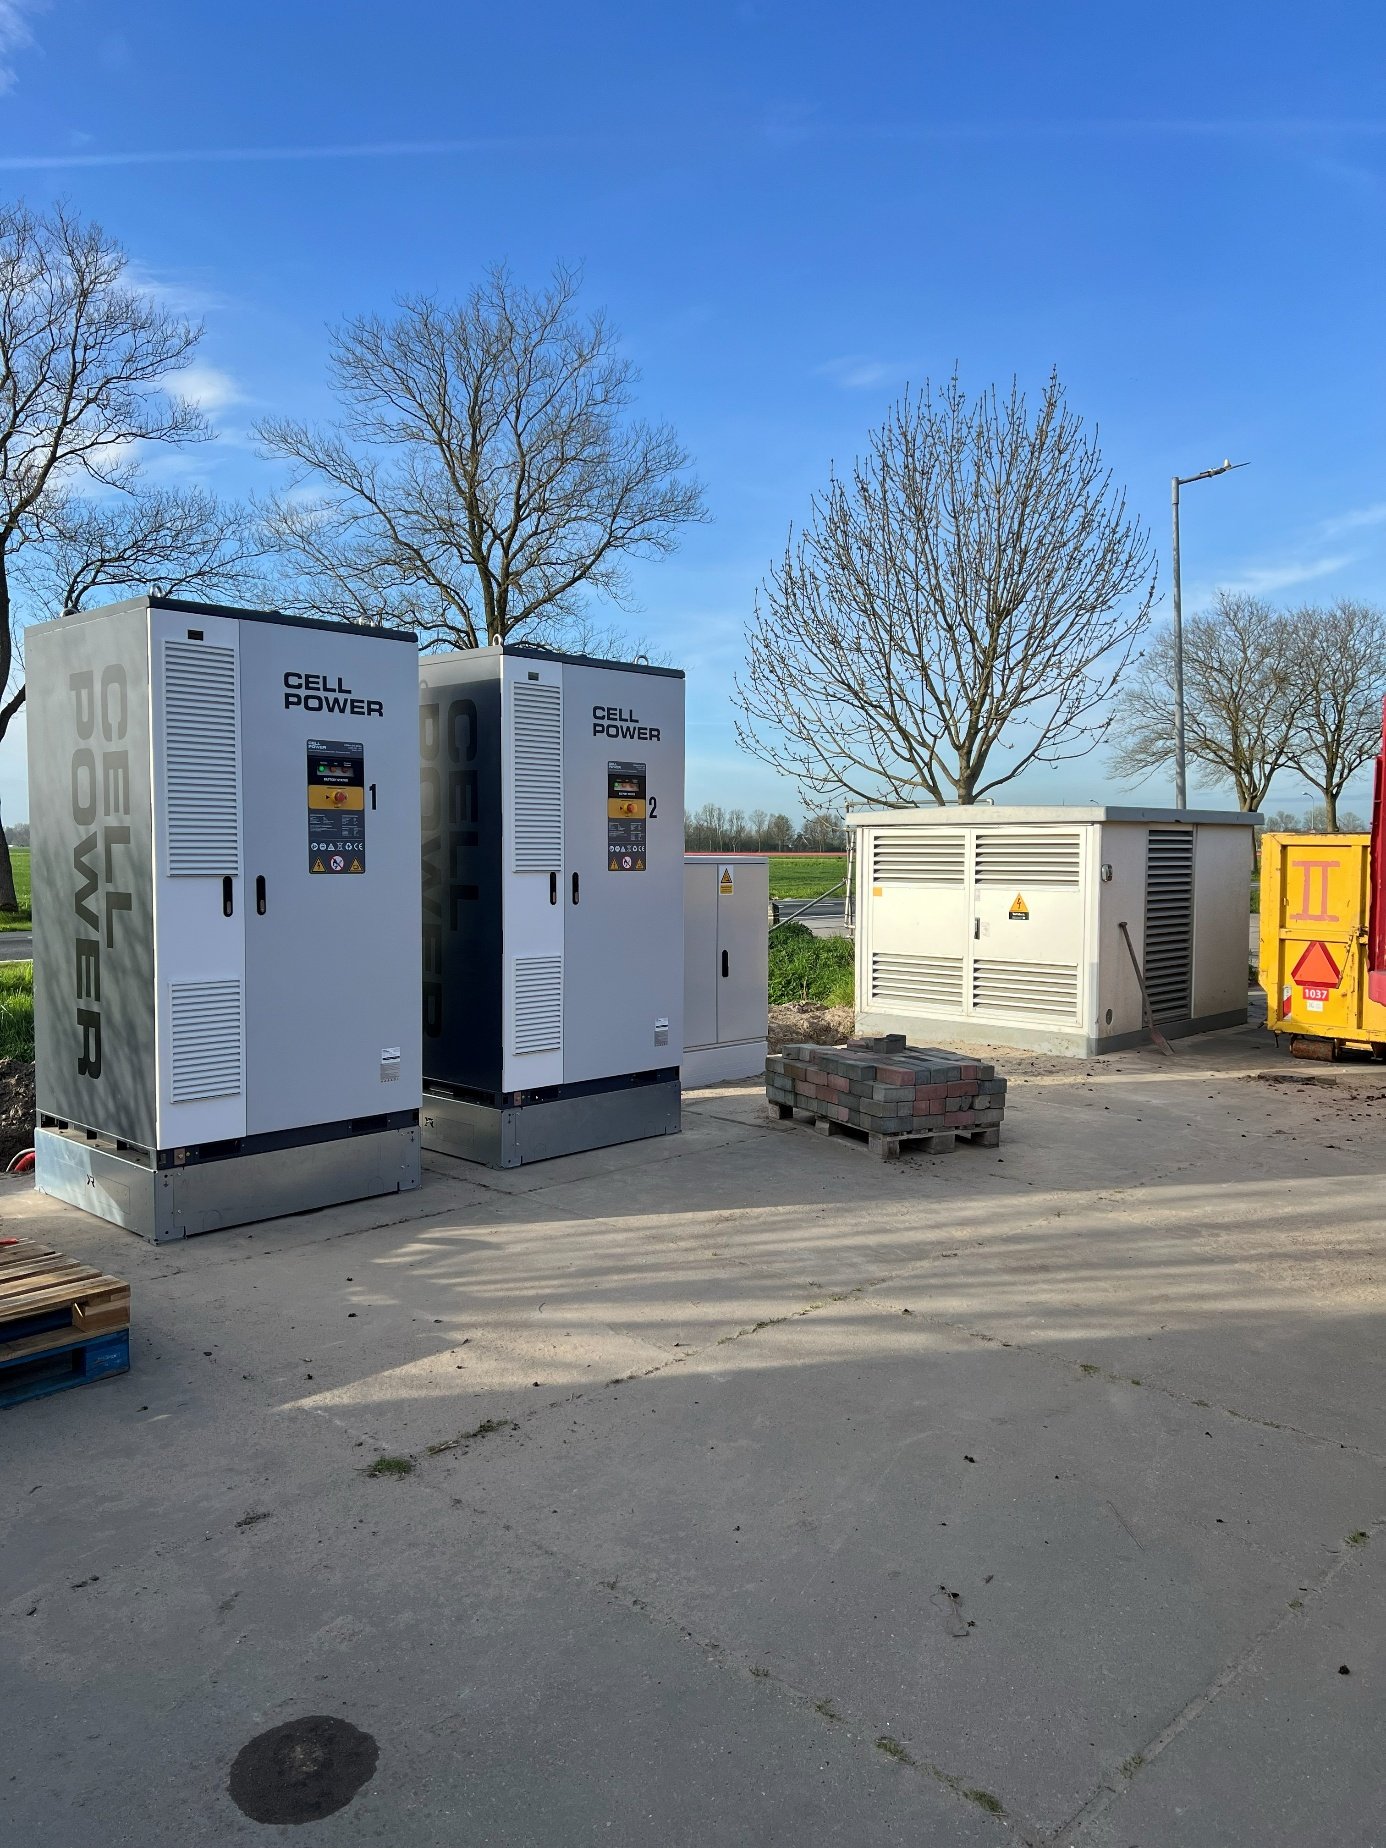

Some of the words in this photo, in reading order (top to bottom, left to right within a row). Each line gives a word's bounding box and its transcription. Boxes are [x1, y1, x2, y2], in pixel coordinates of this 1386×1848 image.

[283, 671, 352, 695] CELL
[284, 692, 384, 718] POWER
[592, 705, 640, 724] CELL
[592, 722, 661, 742] POWER
[100, 663, 133, 949] CELL
[368, 783, 377, 811] 1
[648, 796, 658, 819] 2
[447, 698, 479, 932] CELL
[69, 670, 101, 1080] POWER
[1304, 988, 1328, 999] 1037
